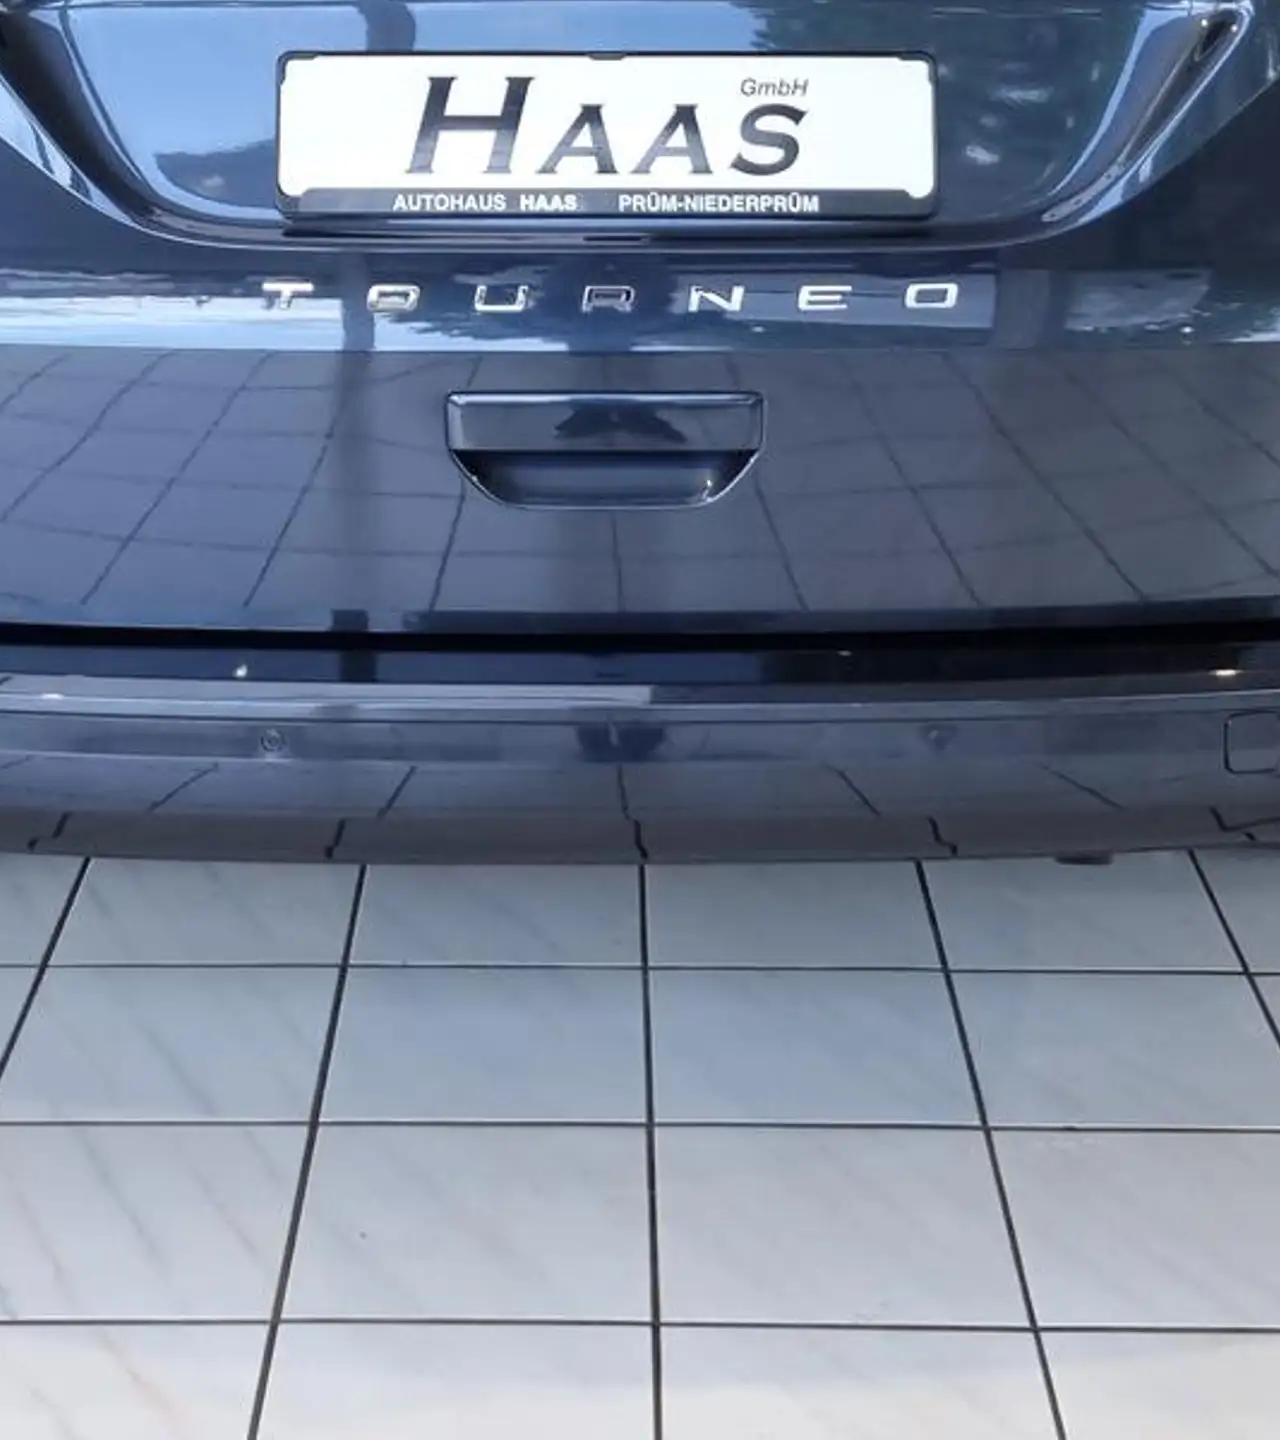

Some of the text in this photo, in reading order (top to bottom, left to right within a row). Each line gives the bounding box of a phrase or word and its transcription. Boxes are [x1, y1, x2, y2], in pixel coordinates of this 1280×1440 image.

[740, 78, 809, 97] GmbH
[405, 76, 808, 176] HAAS
[393, 191, 819, 212] AUTOHAUS HAAS PRÜM-NIEDERPRÜM
[261, 282, 959, 313] TOURNEO
